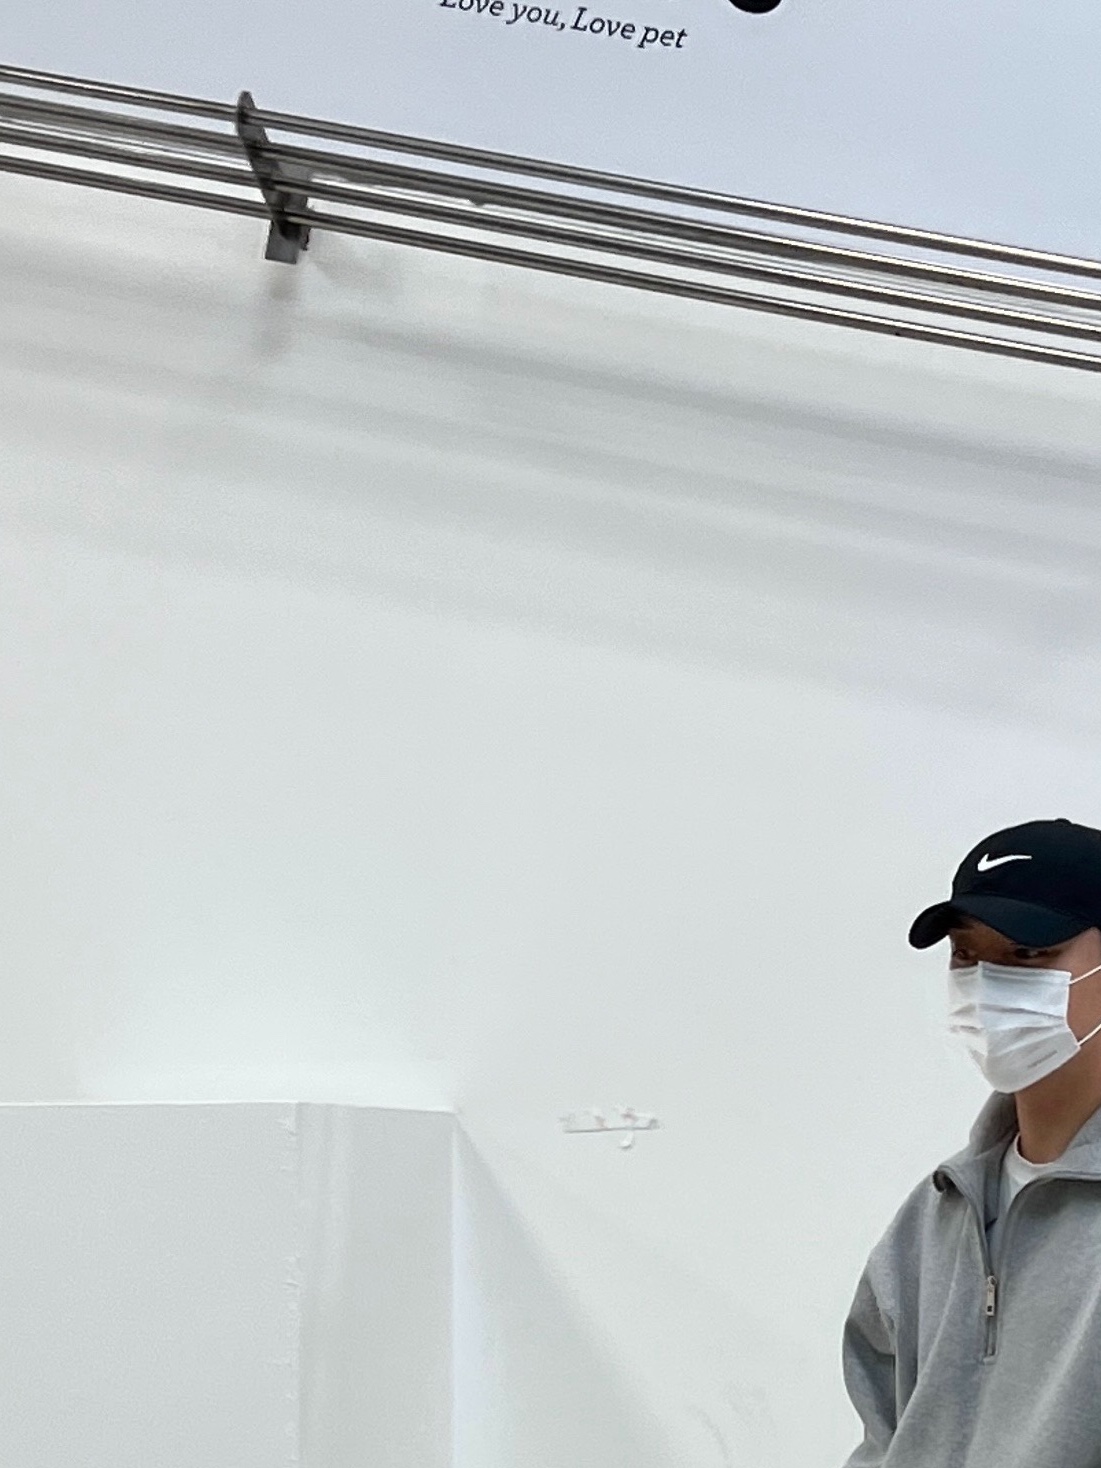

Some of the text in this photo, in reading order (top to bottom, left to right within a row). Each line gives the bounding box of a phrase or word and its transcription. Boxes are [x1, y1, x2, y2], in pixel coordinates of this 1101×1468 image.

[505, 3, 566, 32] you,
[570, 6, 636, 40] Love
[636, 26, 688, 50] pet
